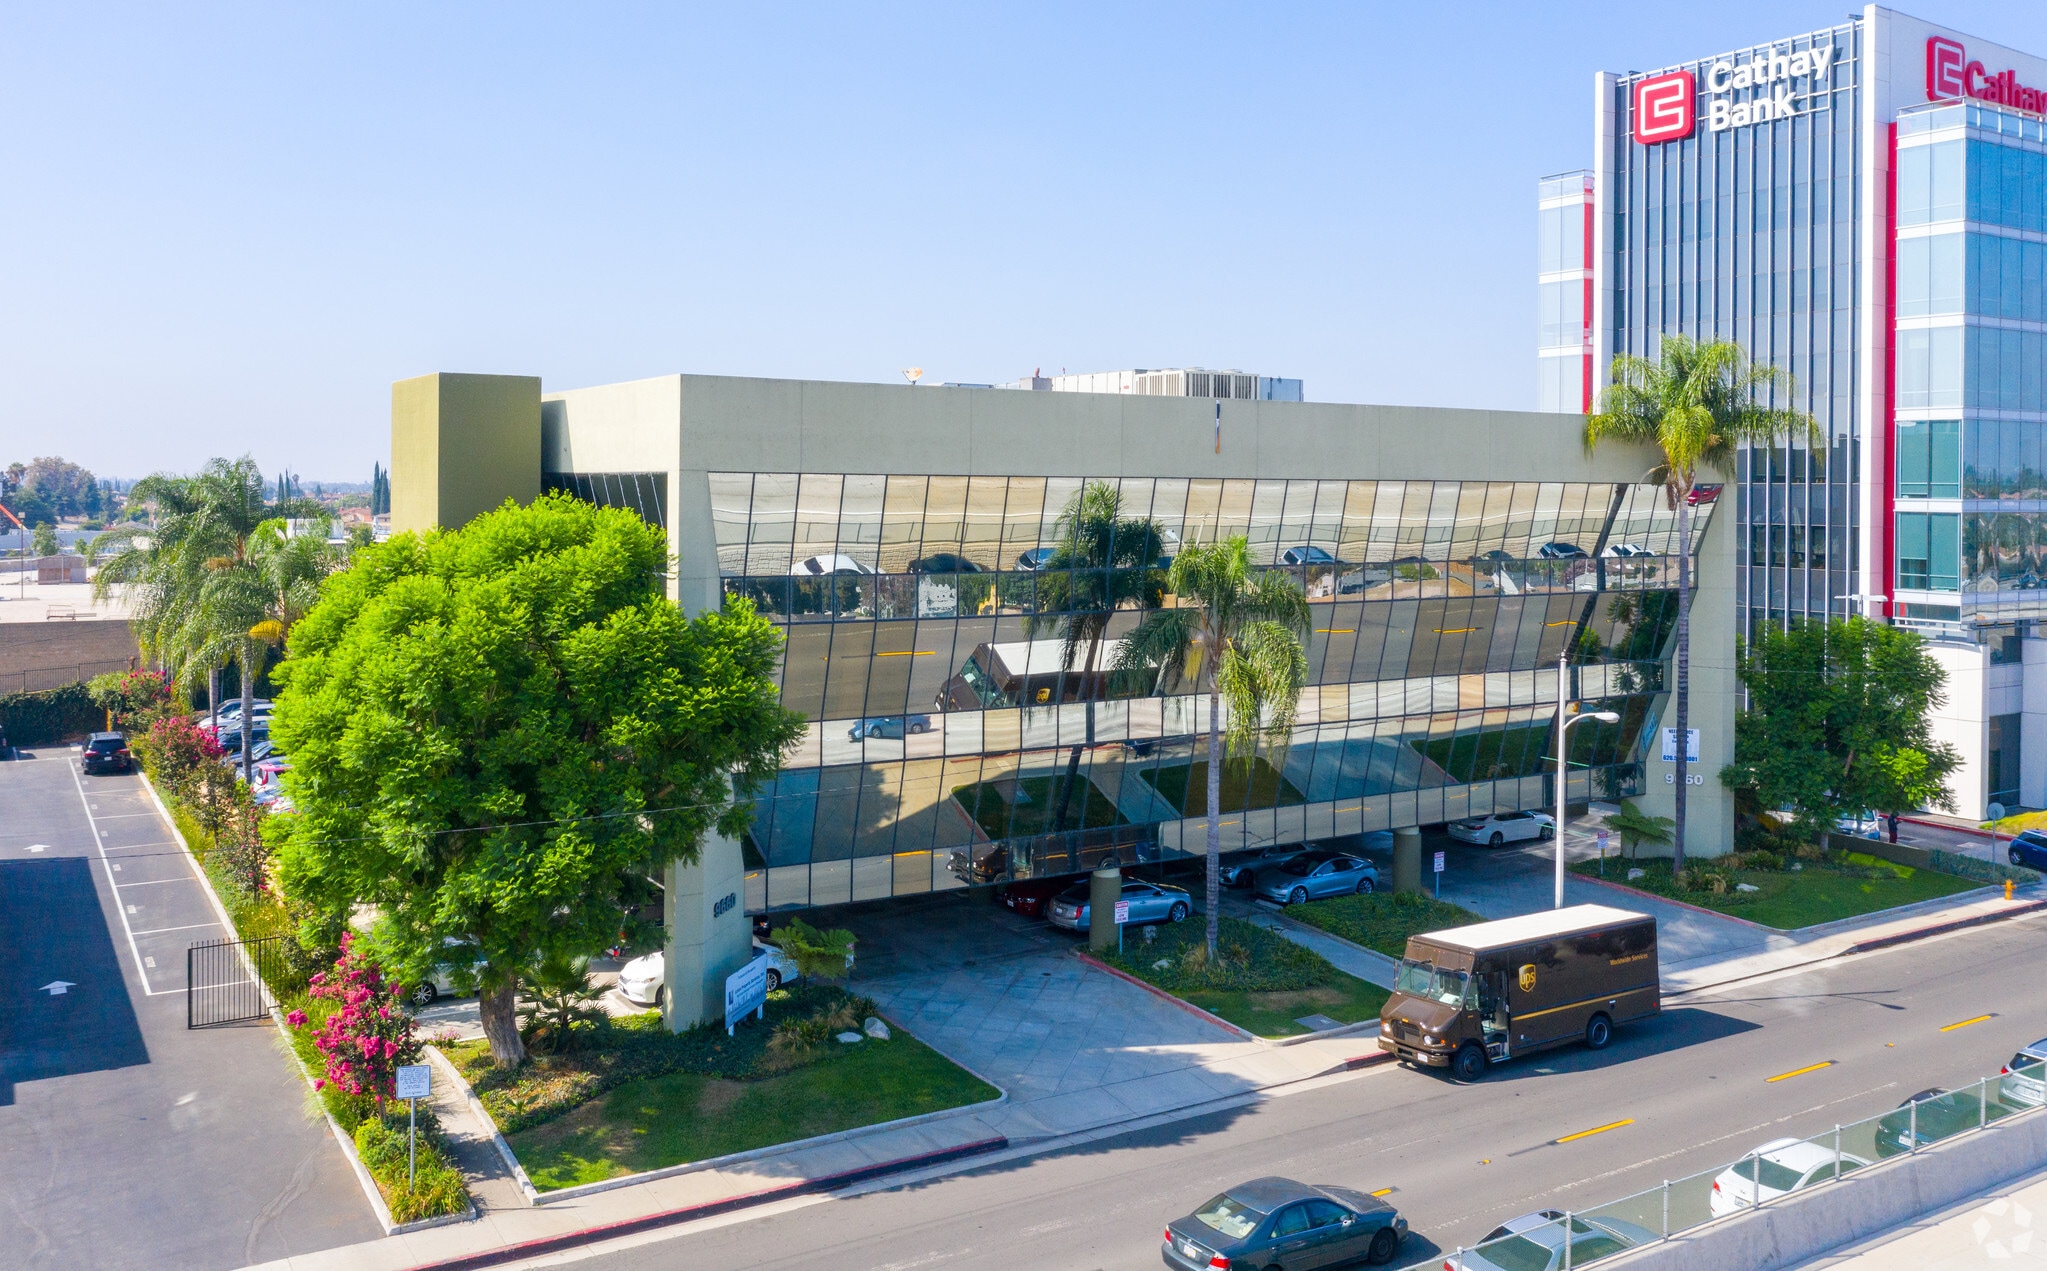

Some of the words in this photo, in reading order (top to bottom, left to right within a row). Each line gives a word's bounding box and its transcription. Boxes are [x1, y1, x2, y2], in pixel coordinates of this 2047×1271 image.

[1707, 44, 1834, 94] Cathay
[1709, 84, 1797, 132] Bank
[1664, 773, 1704, 786] 960
[1520, 972, 1537, 988] ups
